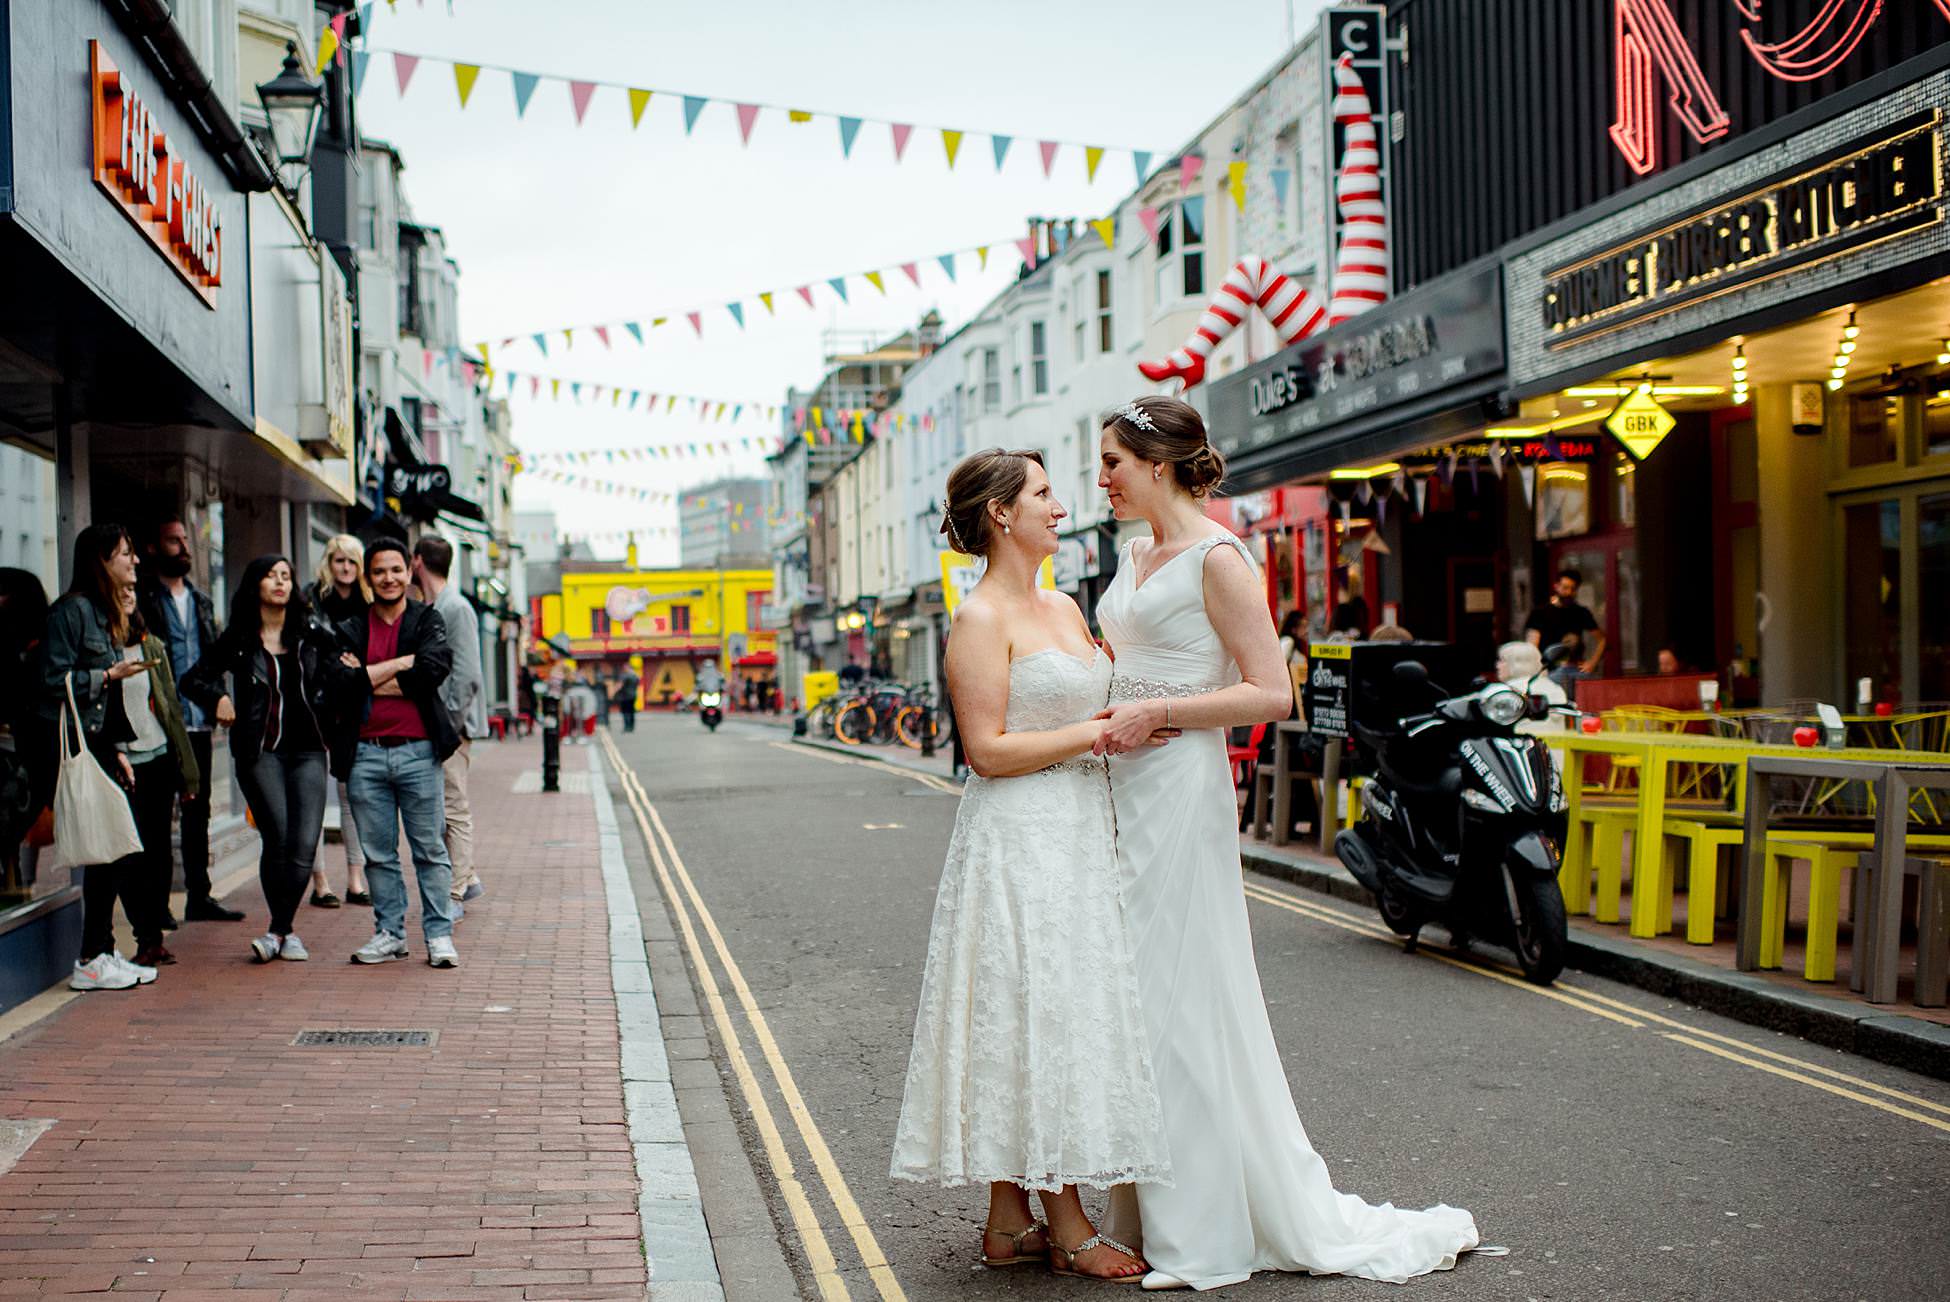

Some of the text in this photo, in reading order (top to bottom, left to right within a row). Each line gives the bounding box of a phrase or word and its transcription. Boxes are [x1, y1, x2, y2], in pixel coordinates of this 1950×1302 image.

[119, 70, 165, 206] THE
[1542, 130, 1934, 329] GOURMET BURGER KITCHEN
[1250, 366, 1298, 416] Duke's
[1318, 356, 1337, 394] at
[1625, 416, 1658, 432] GBK
[1460, 740, 1517, 813] ON THE WHEEL
